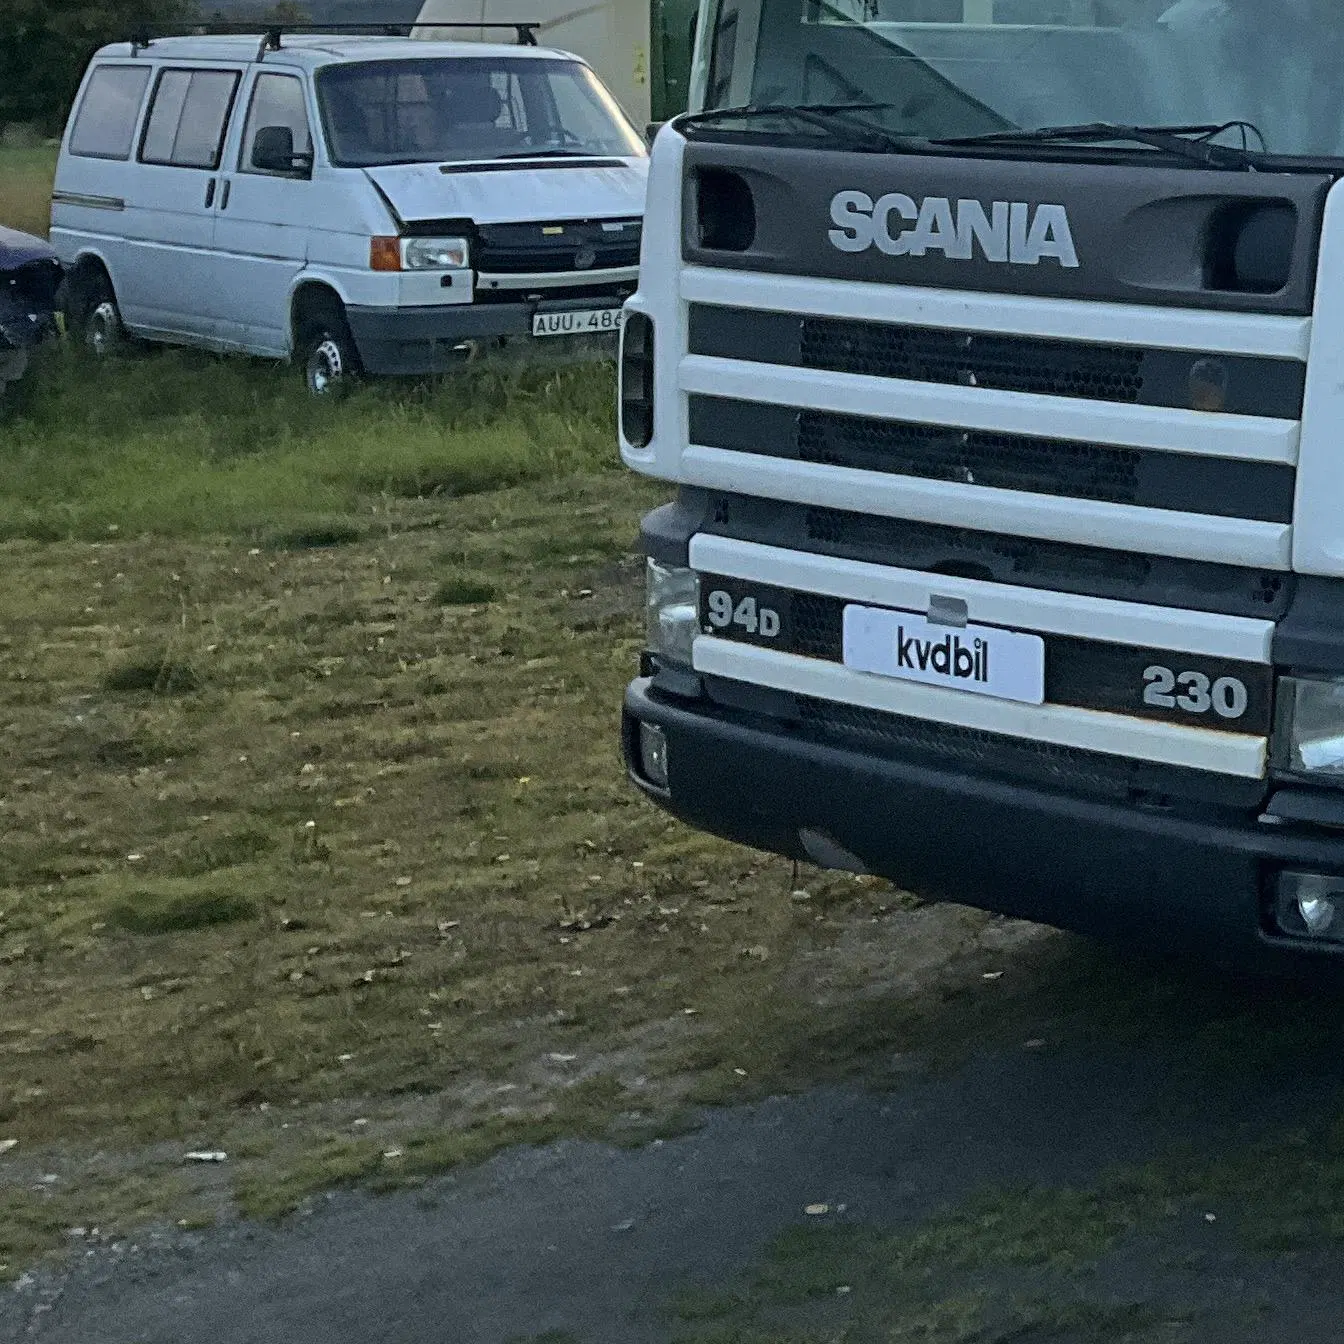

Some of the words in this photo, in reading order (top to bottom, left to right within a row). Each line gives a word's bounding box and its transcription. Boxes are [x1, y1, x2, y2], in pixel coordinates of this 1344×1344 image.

[827, 189, 1081, 269] SCANIA
[708, 589, 781, 637] 94D
[897, 624, 989, 683] kvdbil
[1142, 664, 1249, 720] 230
